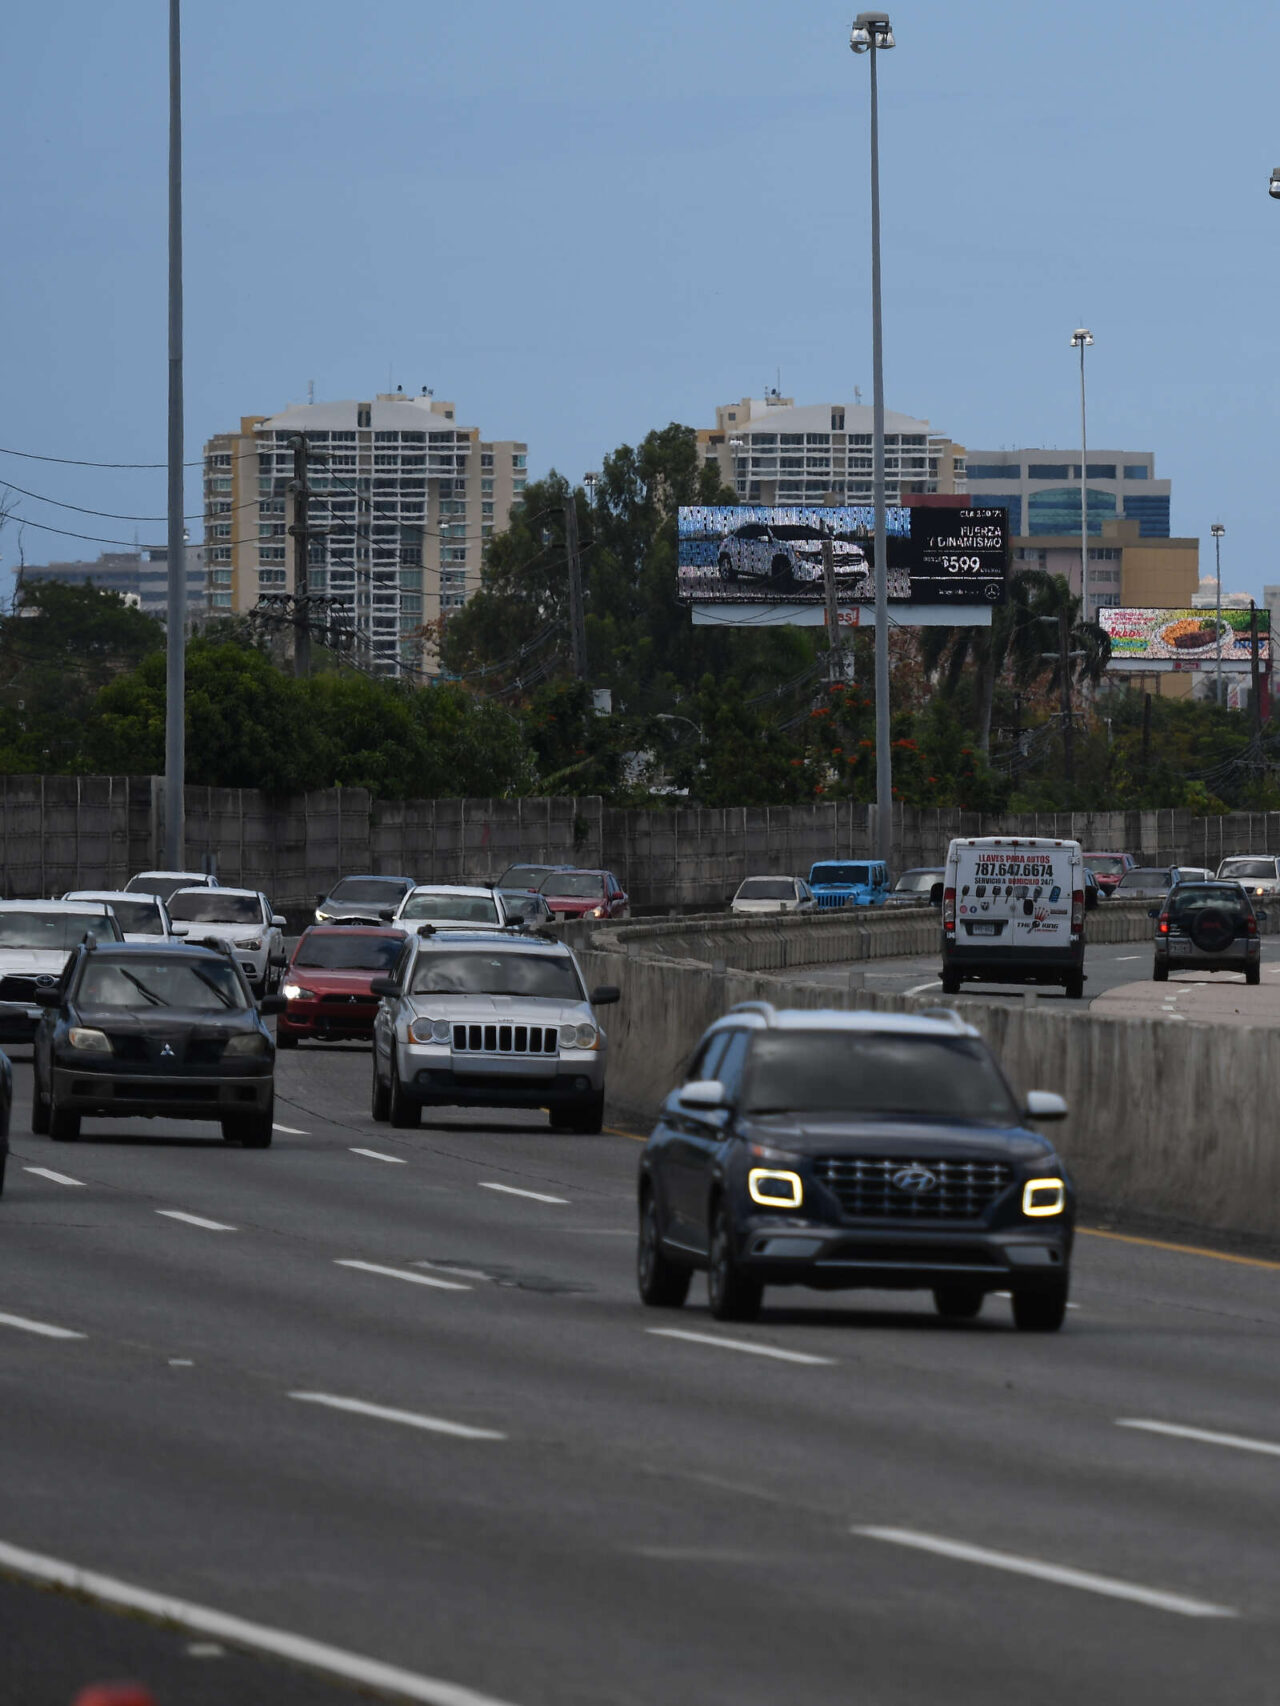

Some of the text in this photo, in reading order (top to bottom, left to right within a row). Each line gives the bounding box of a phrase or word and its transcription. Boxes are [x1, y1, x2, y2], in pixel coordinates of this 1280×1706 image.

[960, 526, 1001, 536] FUERZA
[938, 537, 1001, 547] DINAMISMO
[1006, 855, 1024, 863] PARA
[1026, 855, 1050, 864] AUTOS
[975, 863, 1053, 877] 787.647.6674
[974, 877, 1001, 885] SERVICIO
[1002, 877, 1006, 885] A
[1008, 877, 1040, 885] DOMICILIO
